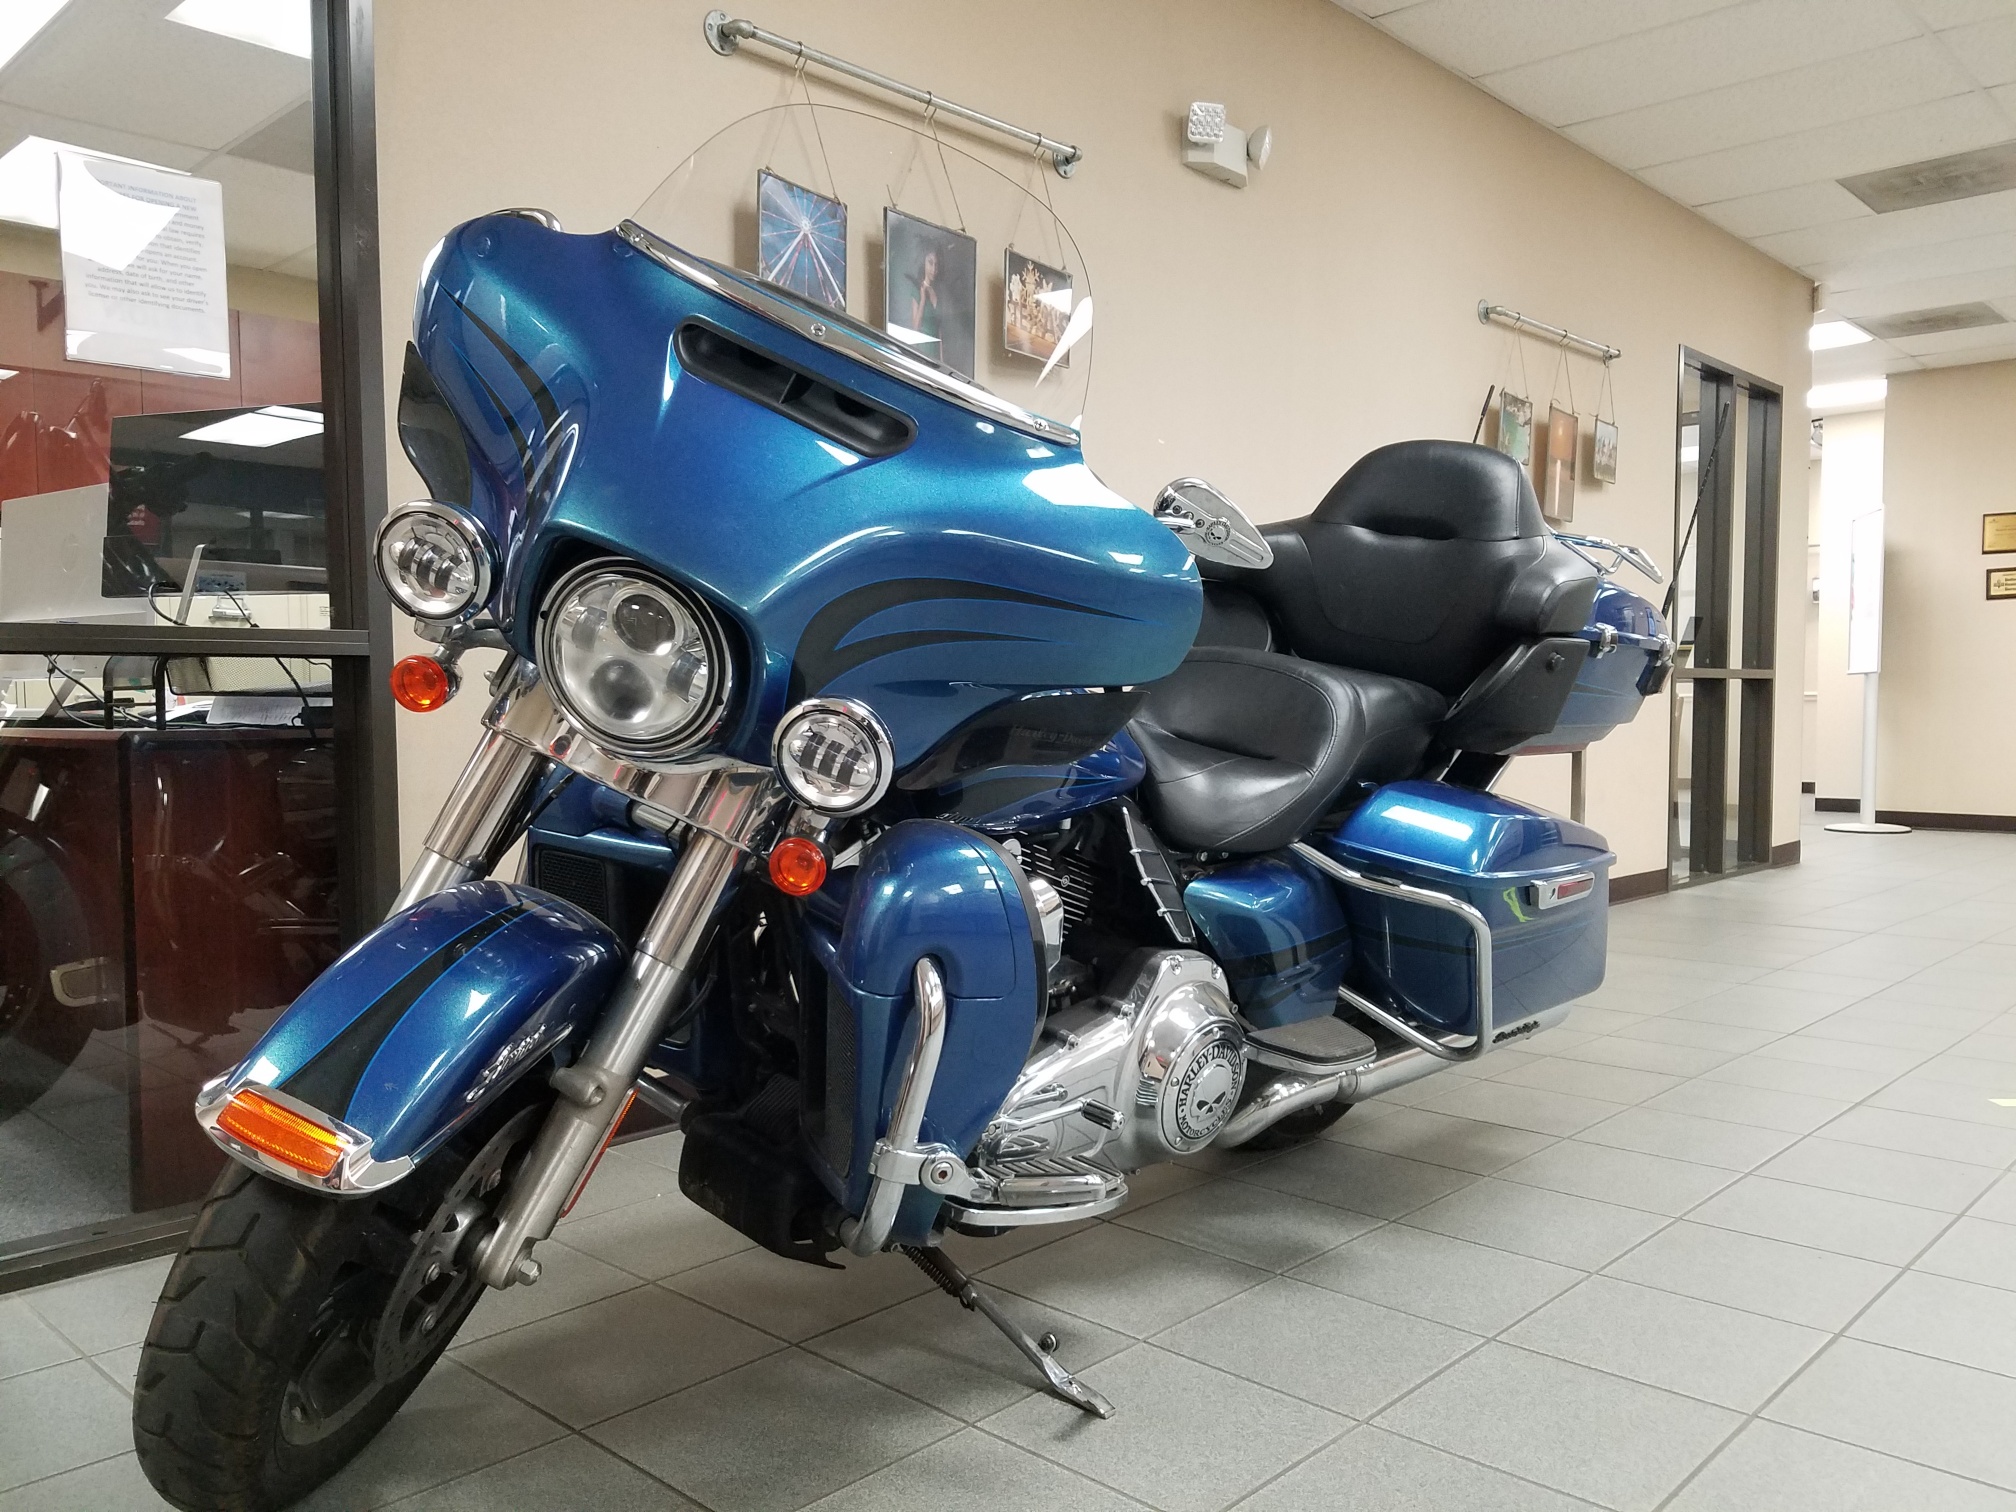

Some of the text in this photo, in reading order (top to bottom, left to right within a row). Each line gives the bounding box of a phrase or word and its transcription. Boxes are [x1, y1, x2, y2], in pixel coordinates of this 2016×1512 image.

[128, 185, 174, 199] INFORMATION
[175, 194, 197, 203] ABOUT
[182, 204, 197, 212] NEW
[184, 222, 204, 231] money
[86, 273, 123, 284] information
[184, 289, 206, 299] identify
[88, 290, 110, 300] license
[127, 288, 140, 296] also
[172, 296, 186, 304] your
[1178, 1043, 1242, 1108] HARLEY-DAVIDSON
[1179, 1098, 1232, 1137] MOTORCYCLES
